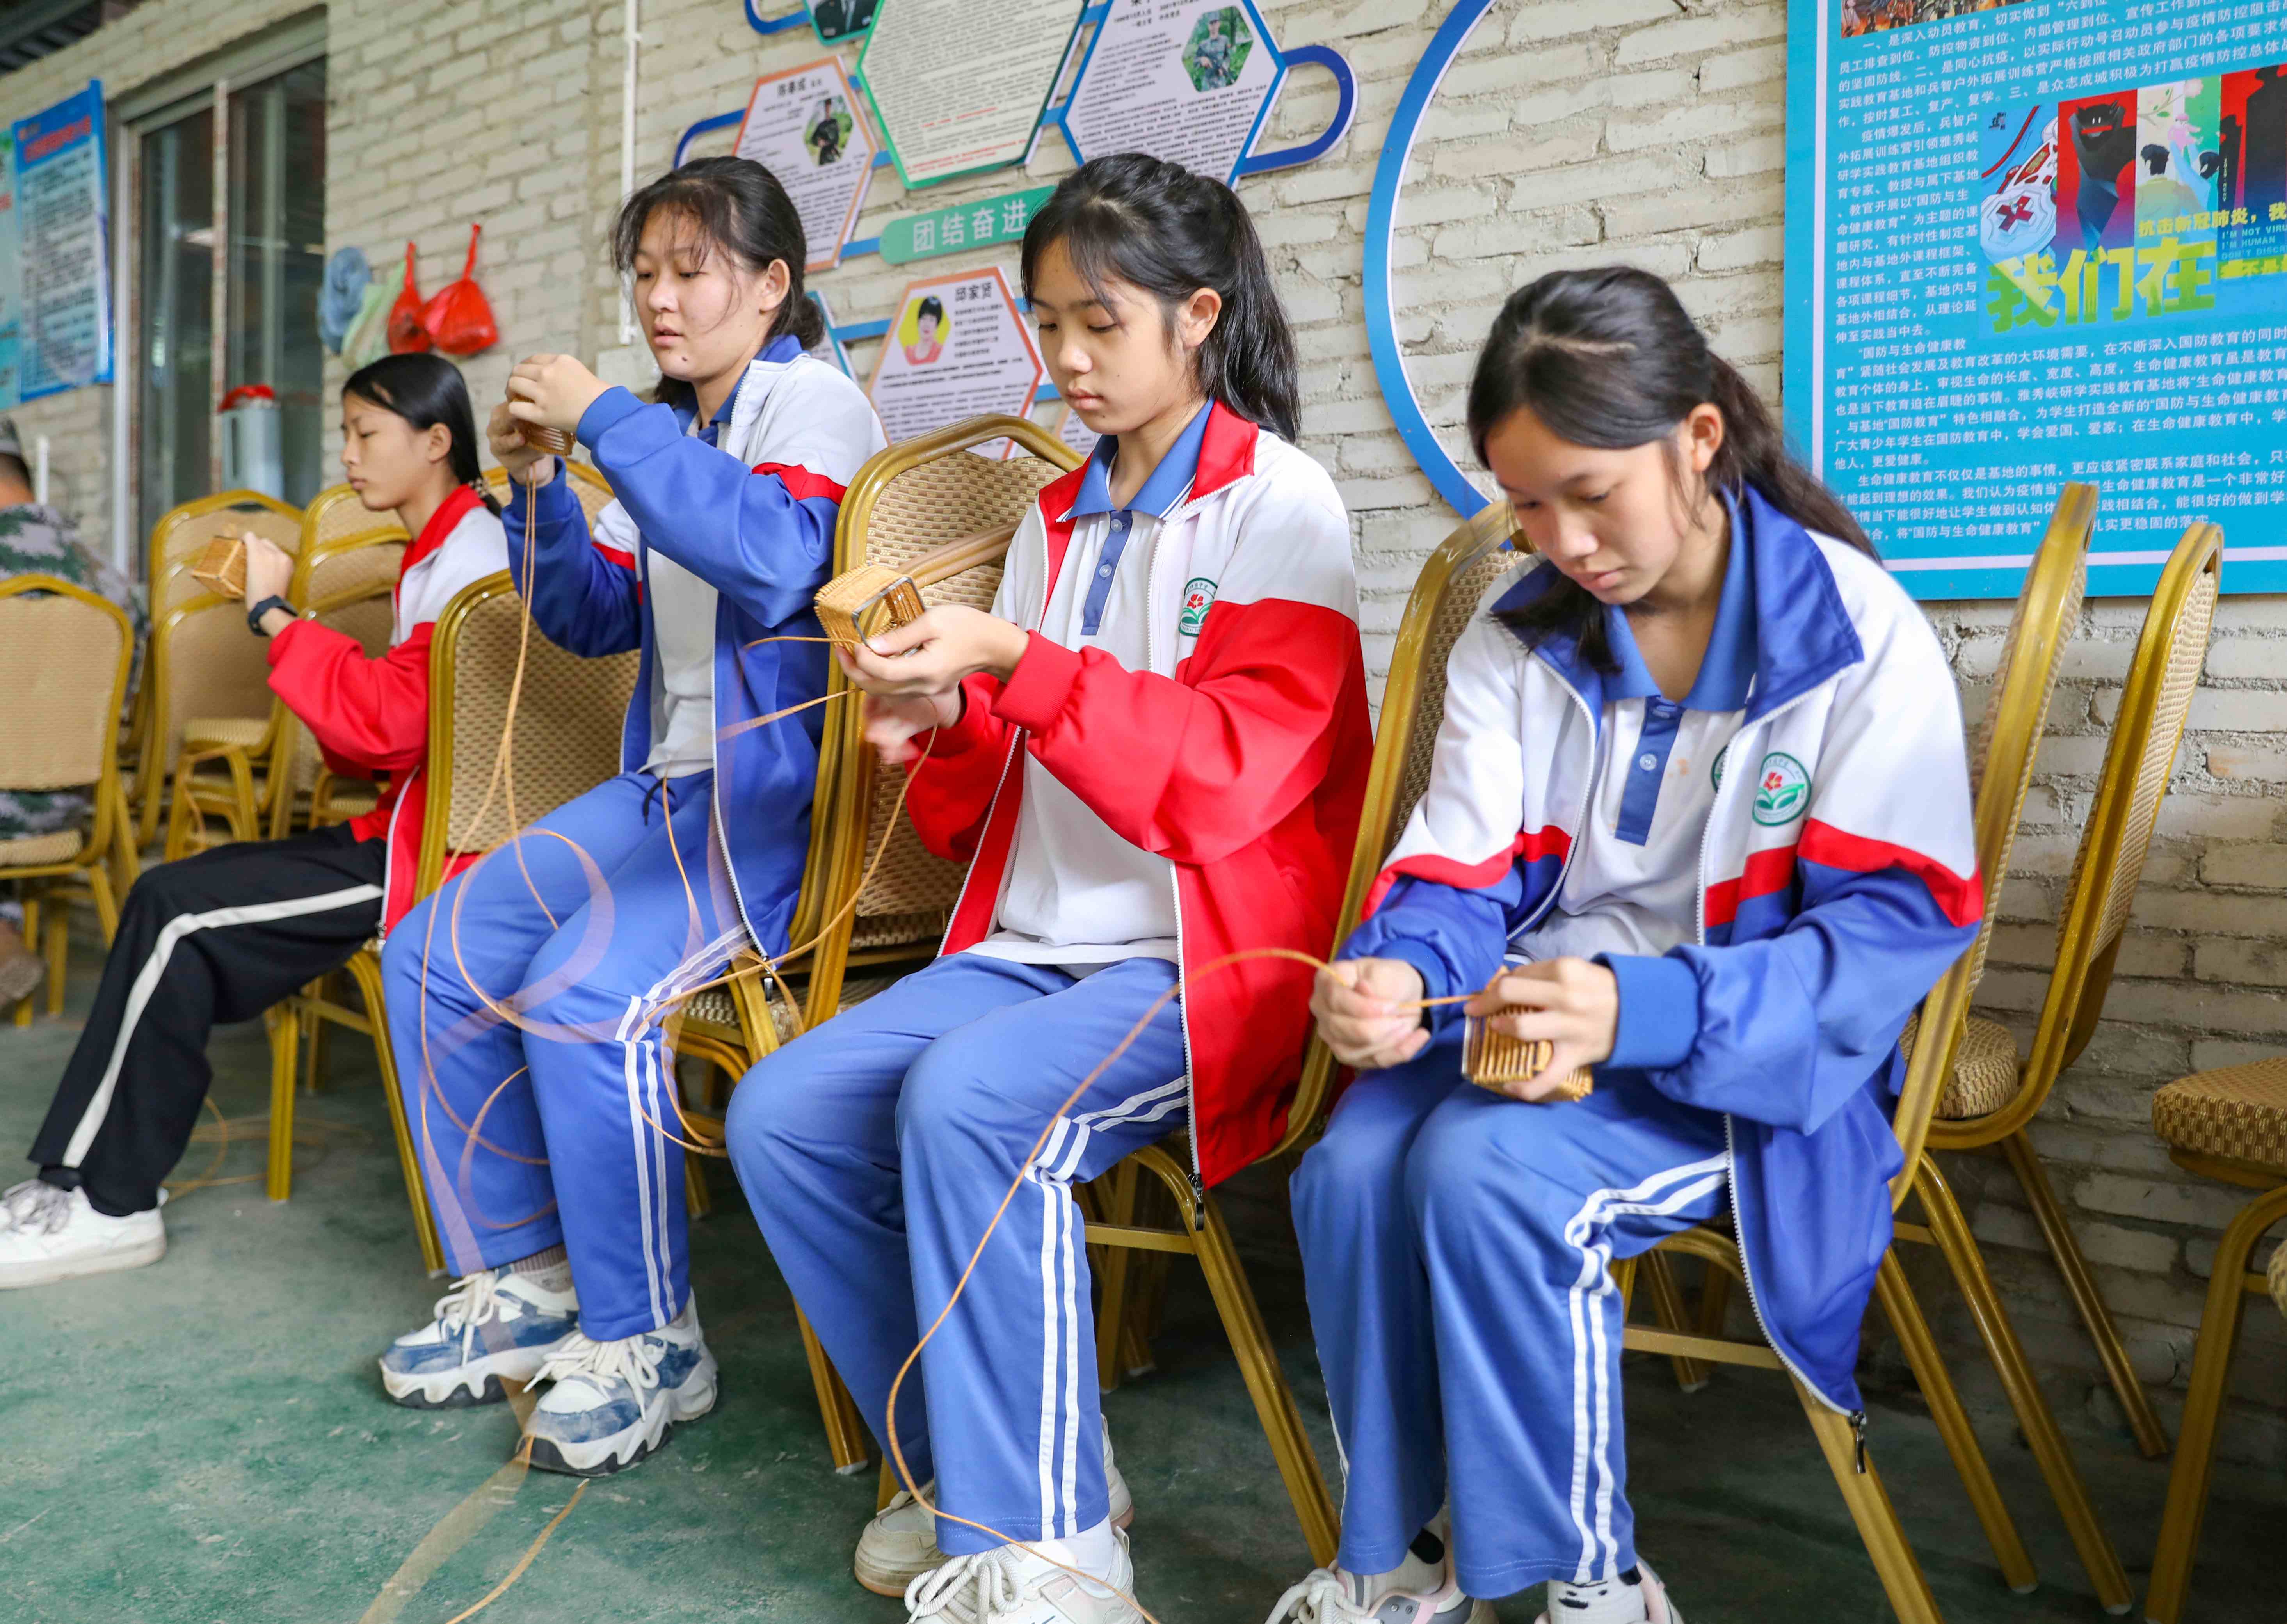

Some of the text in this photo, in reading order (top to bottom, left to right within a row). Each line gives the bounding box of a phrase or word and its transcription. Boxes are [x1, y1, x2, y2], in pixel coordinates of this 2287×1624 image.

[1862, 112, 1977, 142] 疫情爆发后，兵智户
[1838, 131, 1978, 163] 外拓展训练营引领雅秀峡
[1838, 149, 1978, 181] 研学实践教育基地组织教
[1838, 169, 1979, 199] 育专家、教授与属下基地
[913, 199, 1027, 252] 团结奋进
[2242, 227, 2261, 236] NOT
[1837, 225, 1978, 254] 题研究，有针对性制定基
[2242, 236, 2275, 247] HUMAN
[1837, 245, 1970, 271] 地内与基地外课程框架、
[1837, 262, 1977, 289] 课程体系，直至不断完备
[1986, 237, 2216, 333] 我们在
[1836, 281, 1976, 307] 各项课程细节，基地内与
[1836, 300, 1976, 325] 基地外相结合，从理论延
[1836, 324, 1929, 343] 伸至实践当中去。
[1859, 338, 1965, 359] “国防与生命健康教
[1835, 453, 1928, 469] 他人，更爱健康。
[1859, 451, 2287, 486] 生命健康教育不仅仅是基地的事情，更应该紧密联系家庭和社会，只
